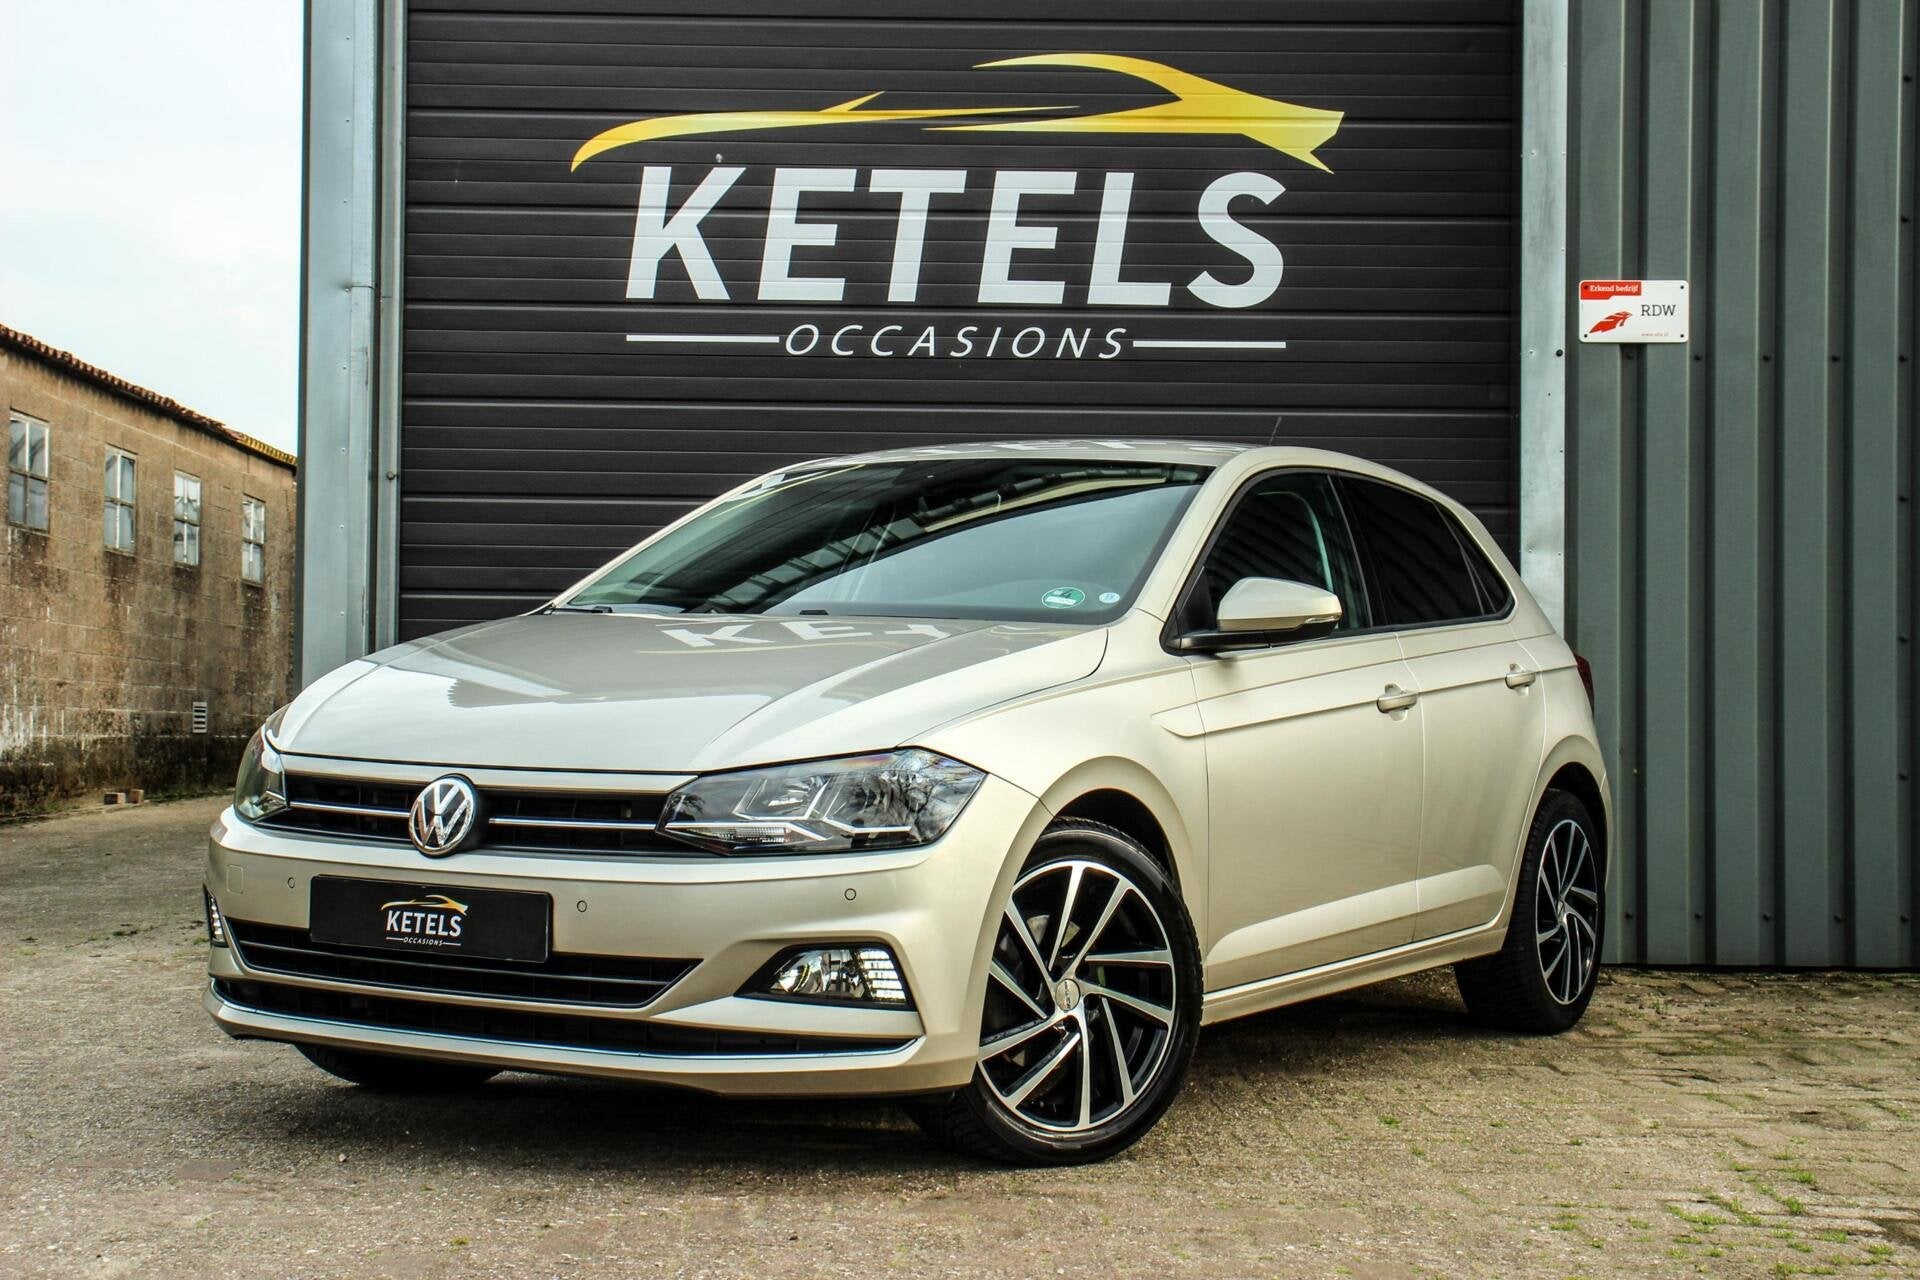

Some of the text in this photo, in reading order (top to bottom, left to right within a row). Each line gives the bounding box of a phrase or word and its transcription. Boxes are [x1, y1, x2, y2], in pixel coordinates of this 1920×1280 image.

[625, 165, 1287, 309] KETELS
[1590, 284, 1639, 294] Erkend bedrijf
[1641, 304, 1677, 317] RDW
[783, 323, 1128, 360] OCCASIONS
[386, 909, 463, 938] KETELS
[403, 936, 444, 947] OCCASIONS
